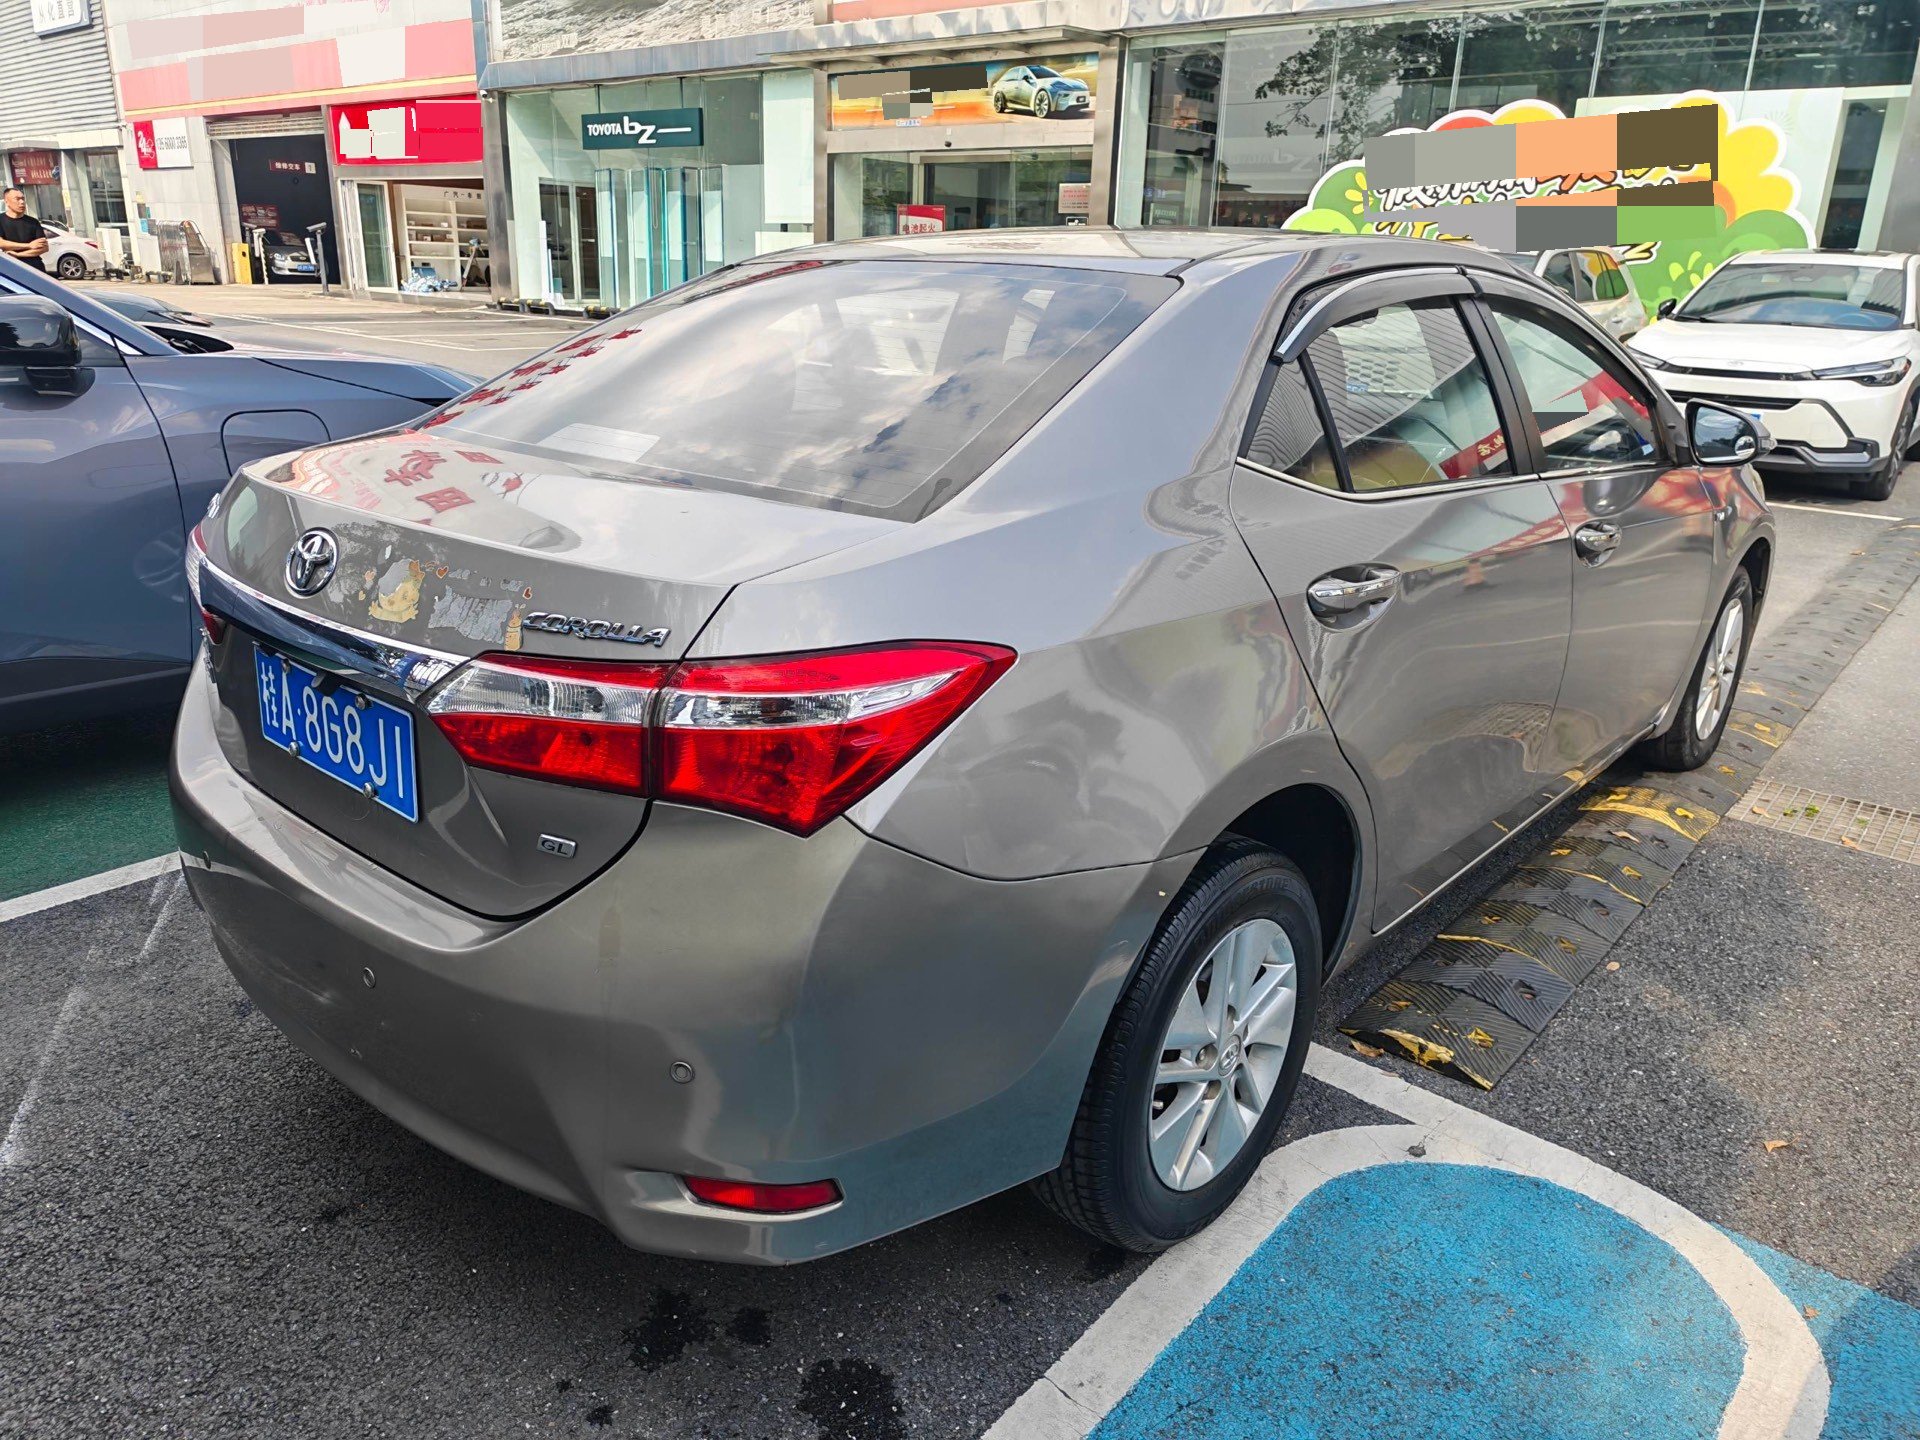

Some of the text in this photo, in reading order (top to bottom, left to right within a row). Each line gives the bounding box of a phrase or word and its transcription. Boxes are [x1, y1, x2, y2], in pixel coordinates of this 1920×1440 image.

[586, 123, 622, 136] TOYOTA
[903, 223, 936, 235] 电池起火
[521, 611, 672, 648] COROLLA
[541, 839, 568, 856] GL
